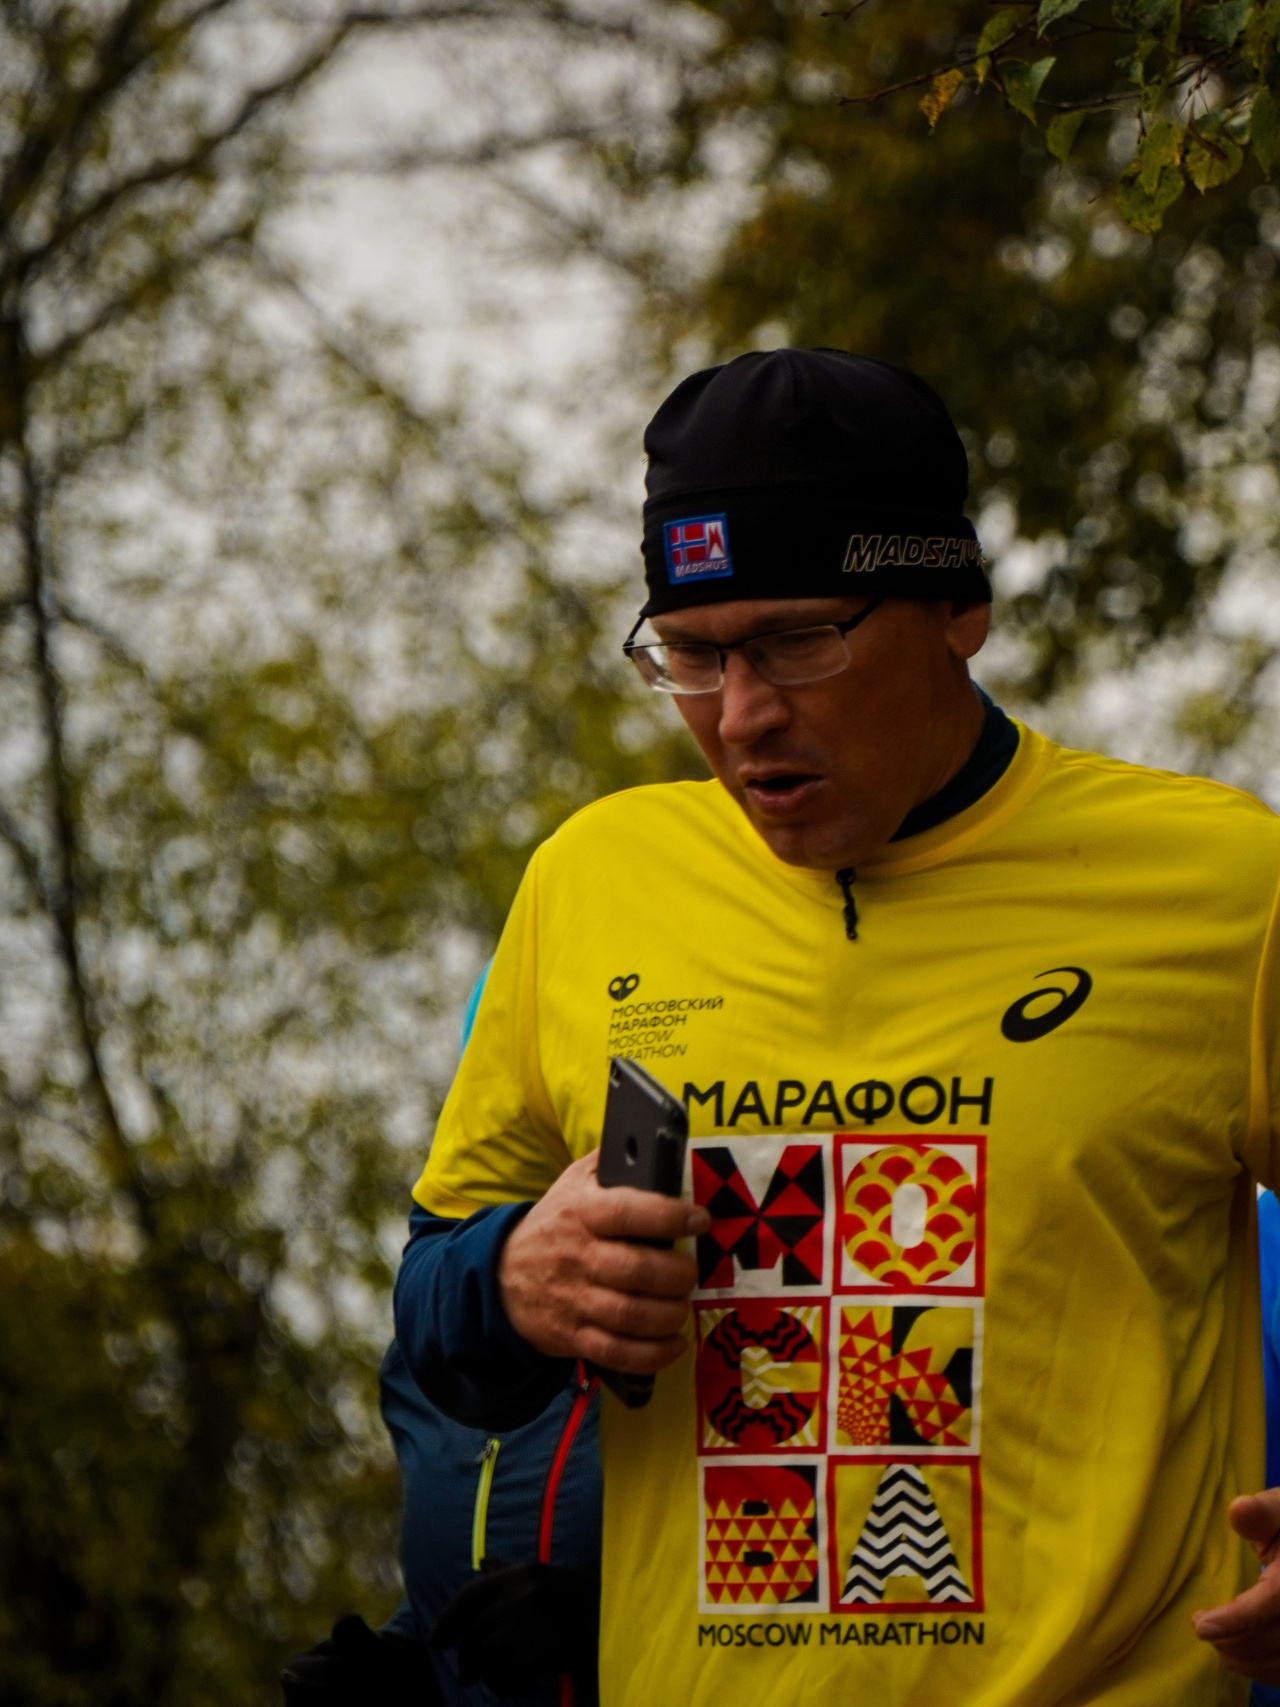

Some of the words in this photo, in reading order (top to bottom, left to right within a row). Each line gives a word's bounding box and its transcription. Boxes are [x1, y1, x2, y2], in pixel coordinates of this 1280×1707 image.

[842, 534, 984, 572] MADSHU
[675, 559, 729, 579] MADSHUS
[611, 996, 725, 1020] МОСКОВСКИЙ
[609, 1014, 687, 1035] МАРАФОН
[607, 1030, 675, 1051] MOSCOW
[682, 1076, 994, 1127] МАРАФОН
[698, 1623, 812, 1647] MOSCOW
[820, 1621, 985, 1646] MARATHON
